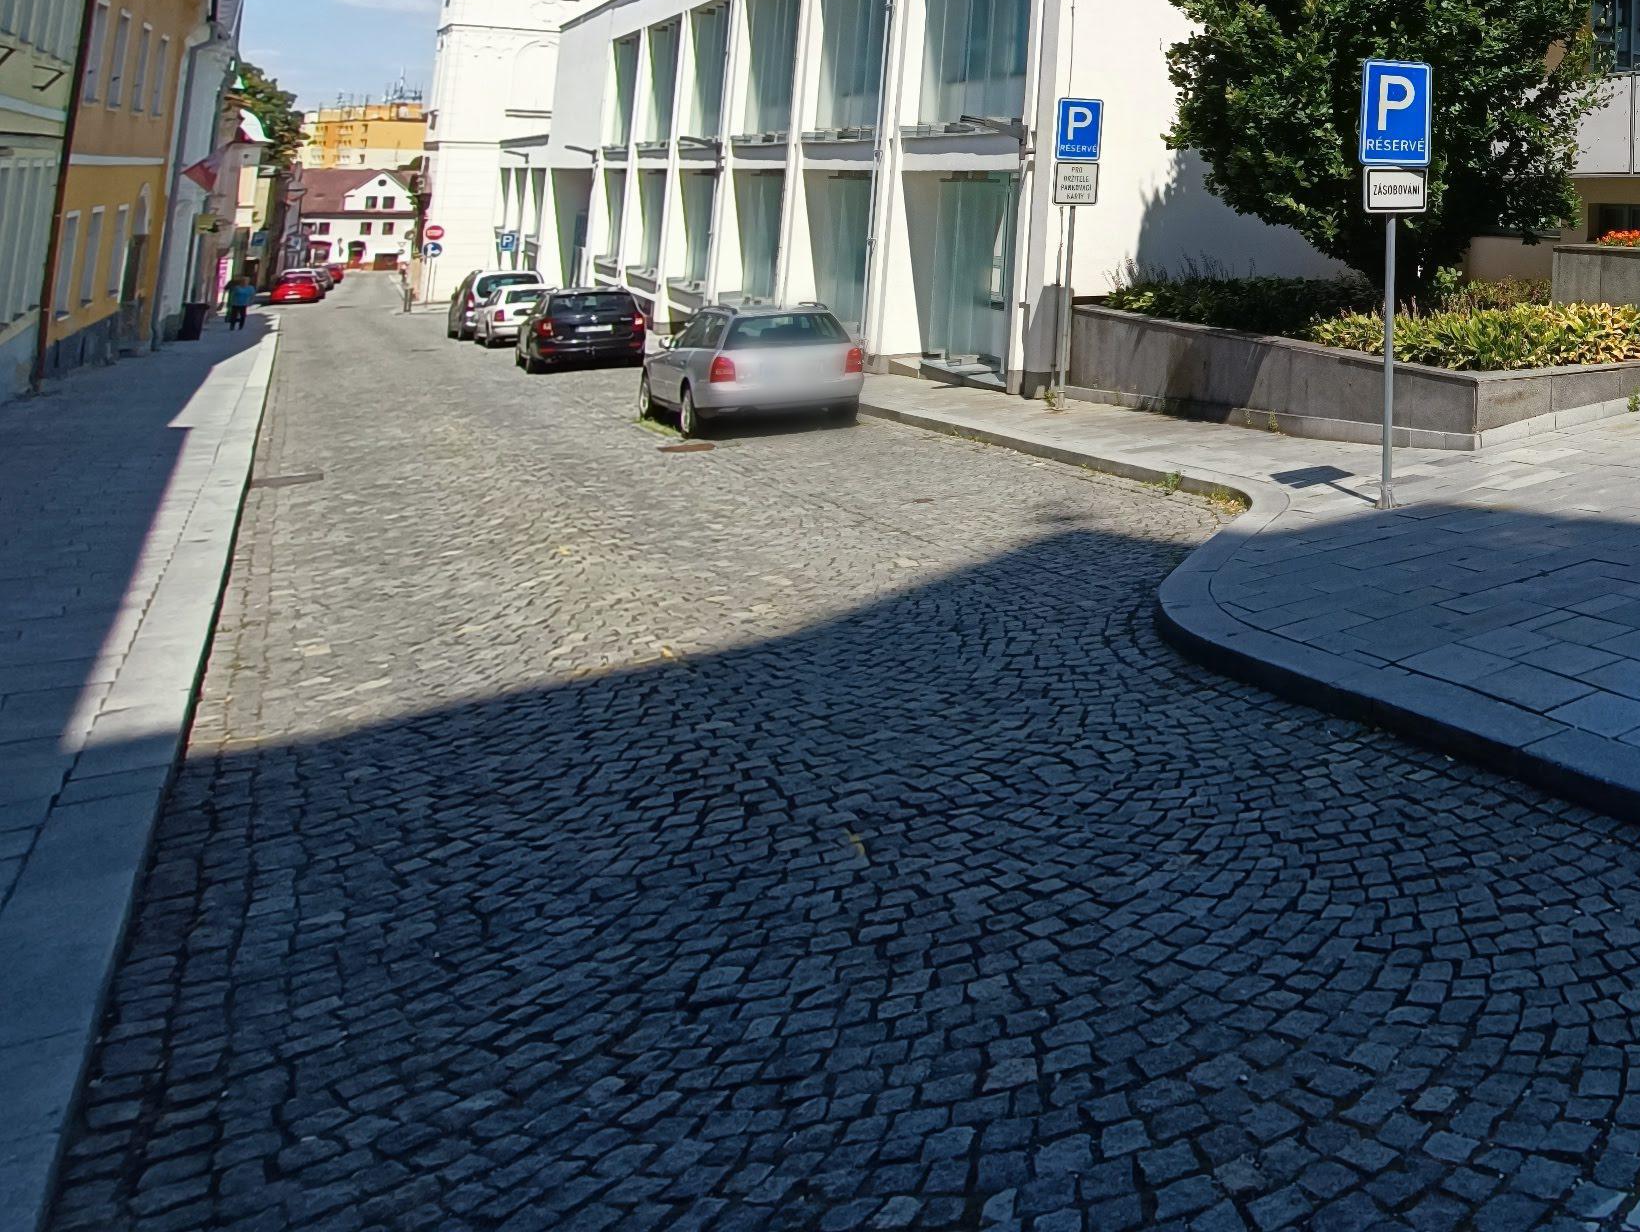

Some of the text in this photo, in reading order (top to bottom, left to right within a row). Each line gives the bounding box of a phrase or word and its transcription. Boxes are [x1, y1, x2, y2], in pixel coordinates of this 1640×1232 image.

[1378, 74, 1416, 131] P
[1067, 106, 1093, 141] P
[1060, 142, 1098, 154] RÉSERVÉ
[1366, 135, 1425, 152] RÉSERVÉ
[1373, 182, 1420, 196] ZÁSOBOVÁNÍ
[502, 235, 514, 247] P
